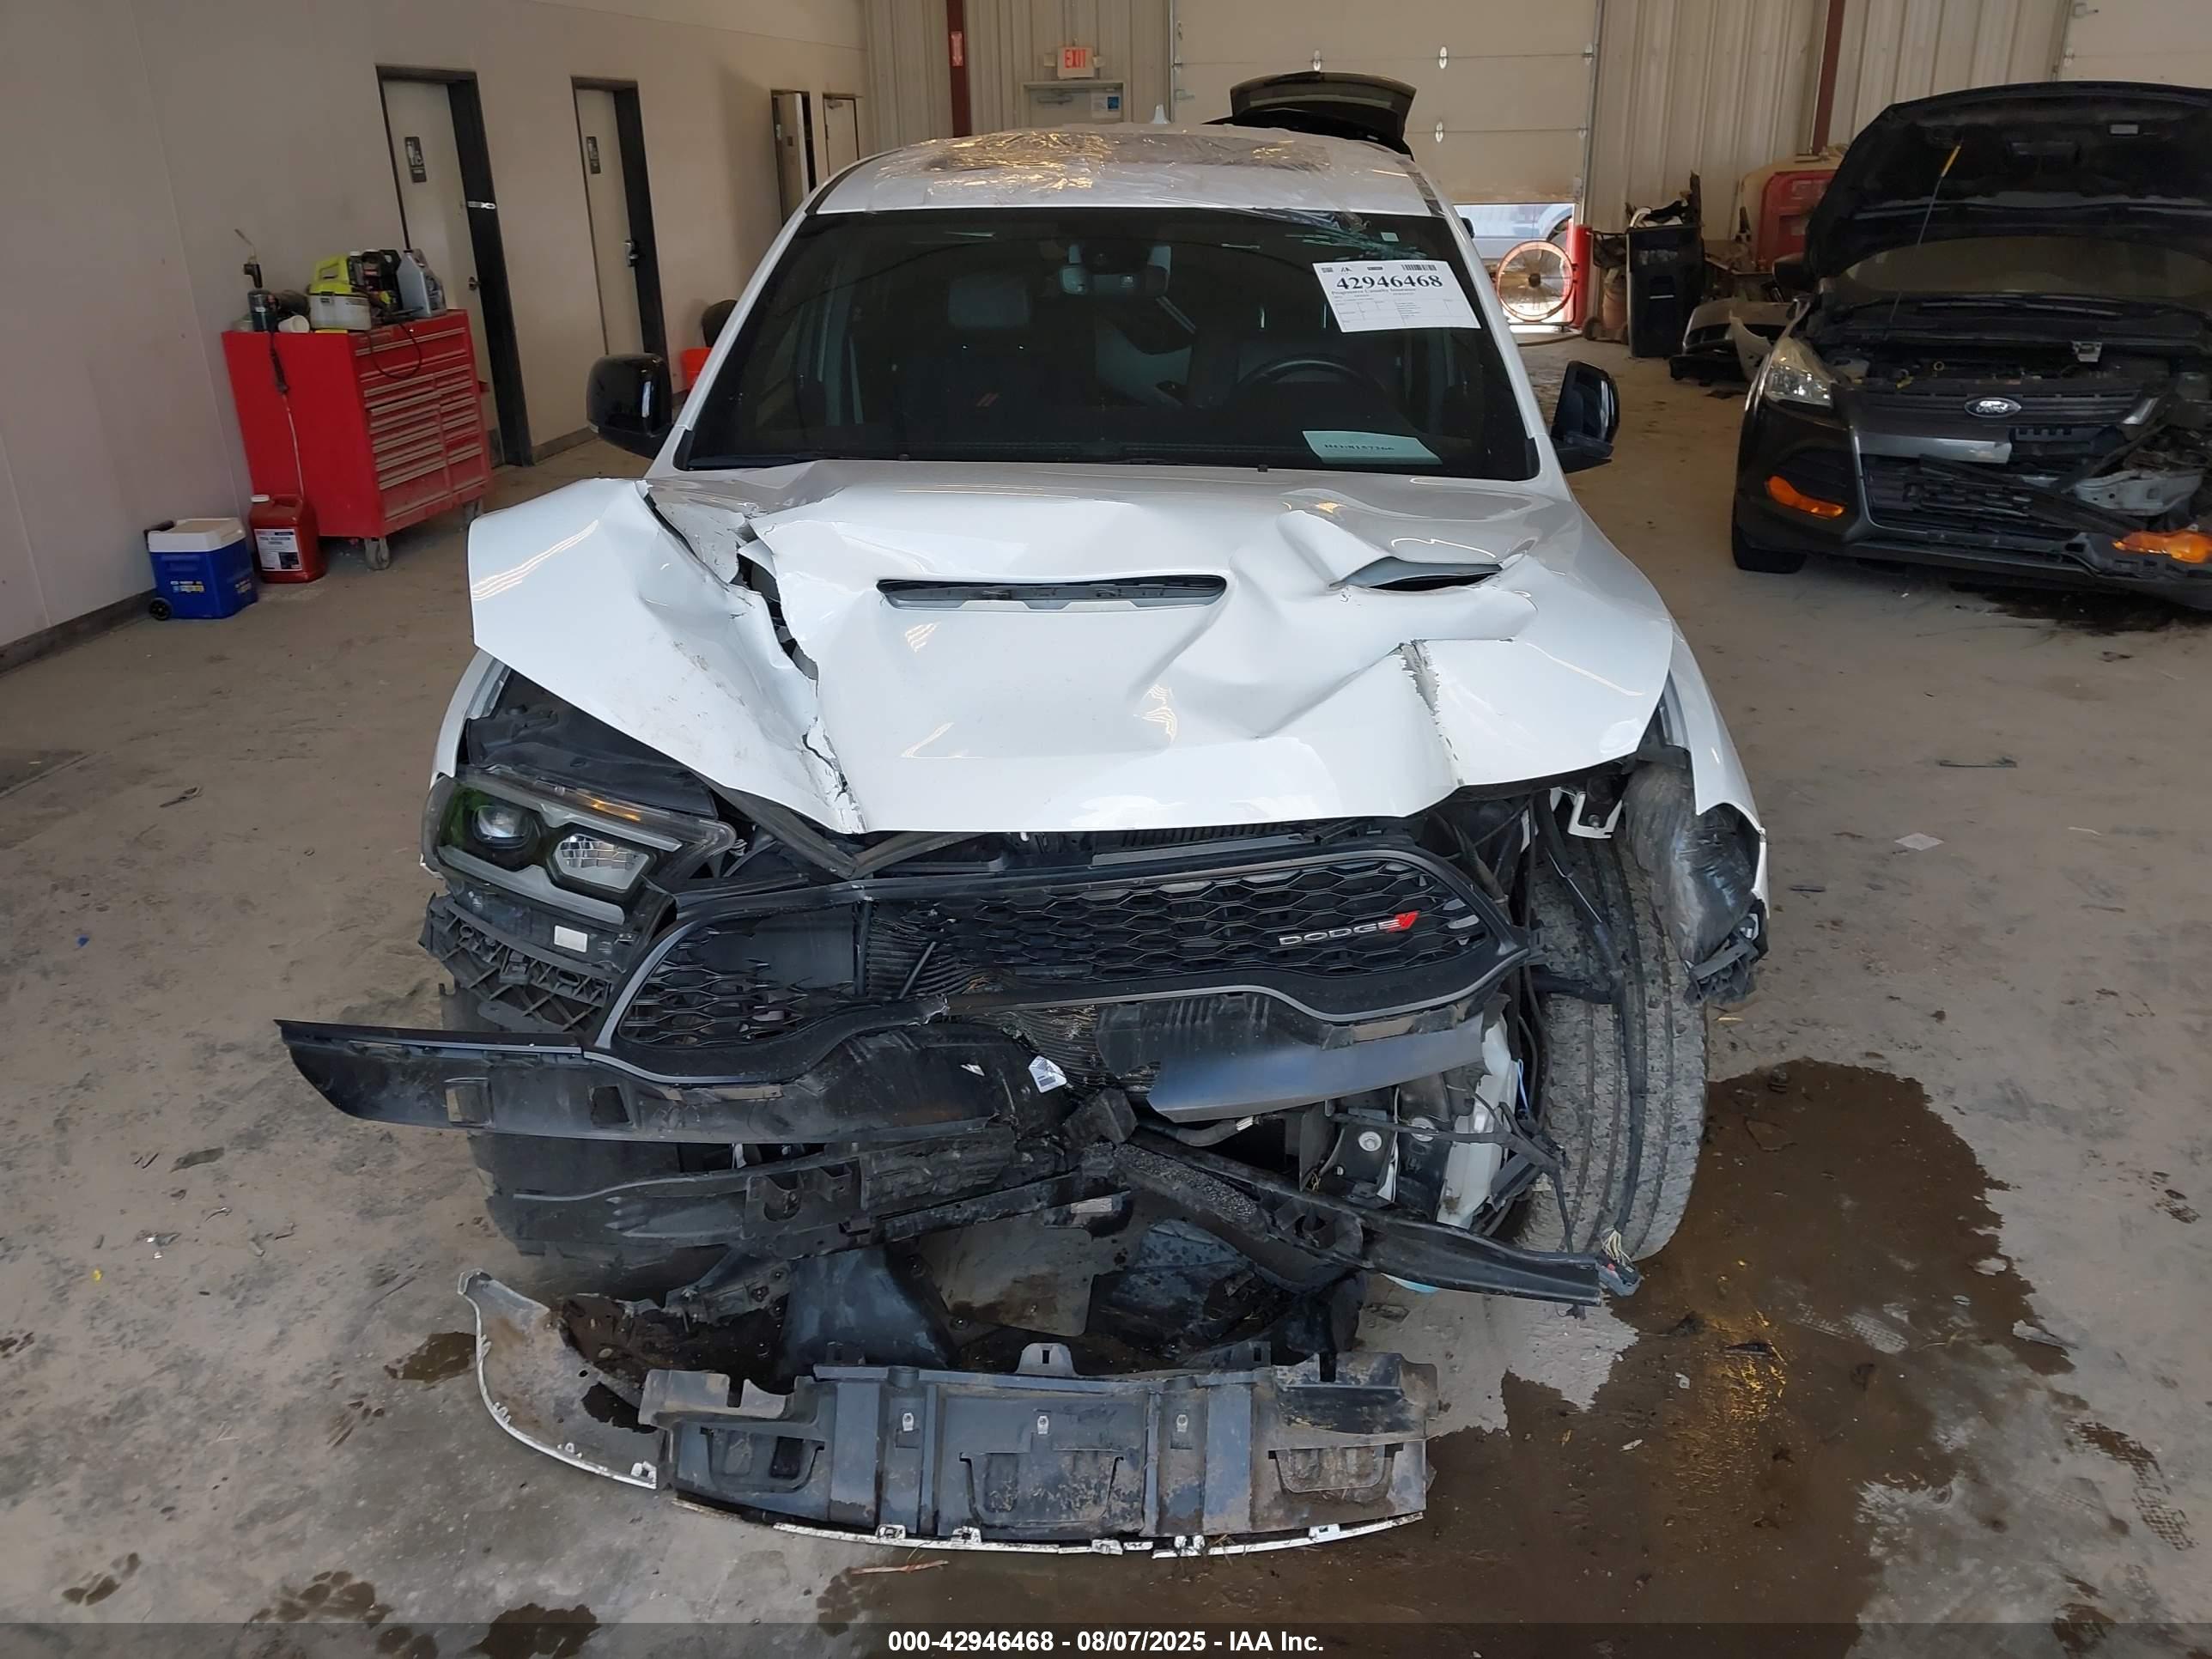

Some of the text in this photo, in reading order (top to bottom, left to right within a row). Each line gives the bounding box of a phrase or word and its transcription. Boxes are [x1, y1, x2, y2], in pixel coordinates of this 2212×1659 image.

[1065, 49, 1086, 69] EXIT
[1336, 275, 1443, 289] 42946468
[1279, 919, 1401, 945] DODGE
